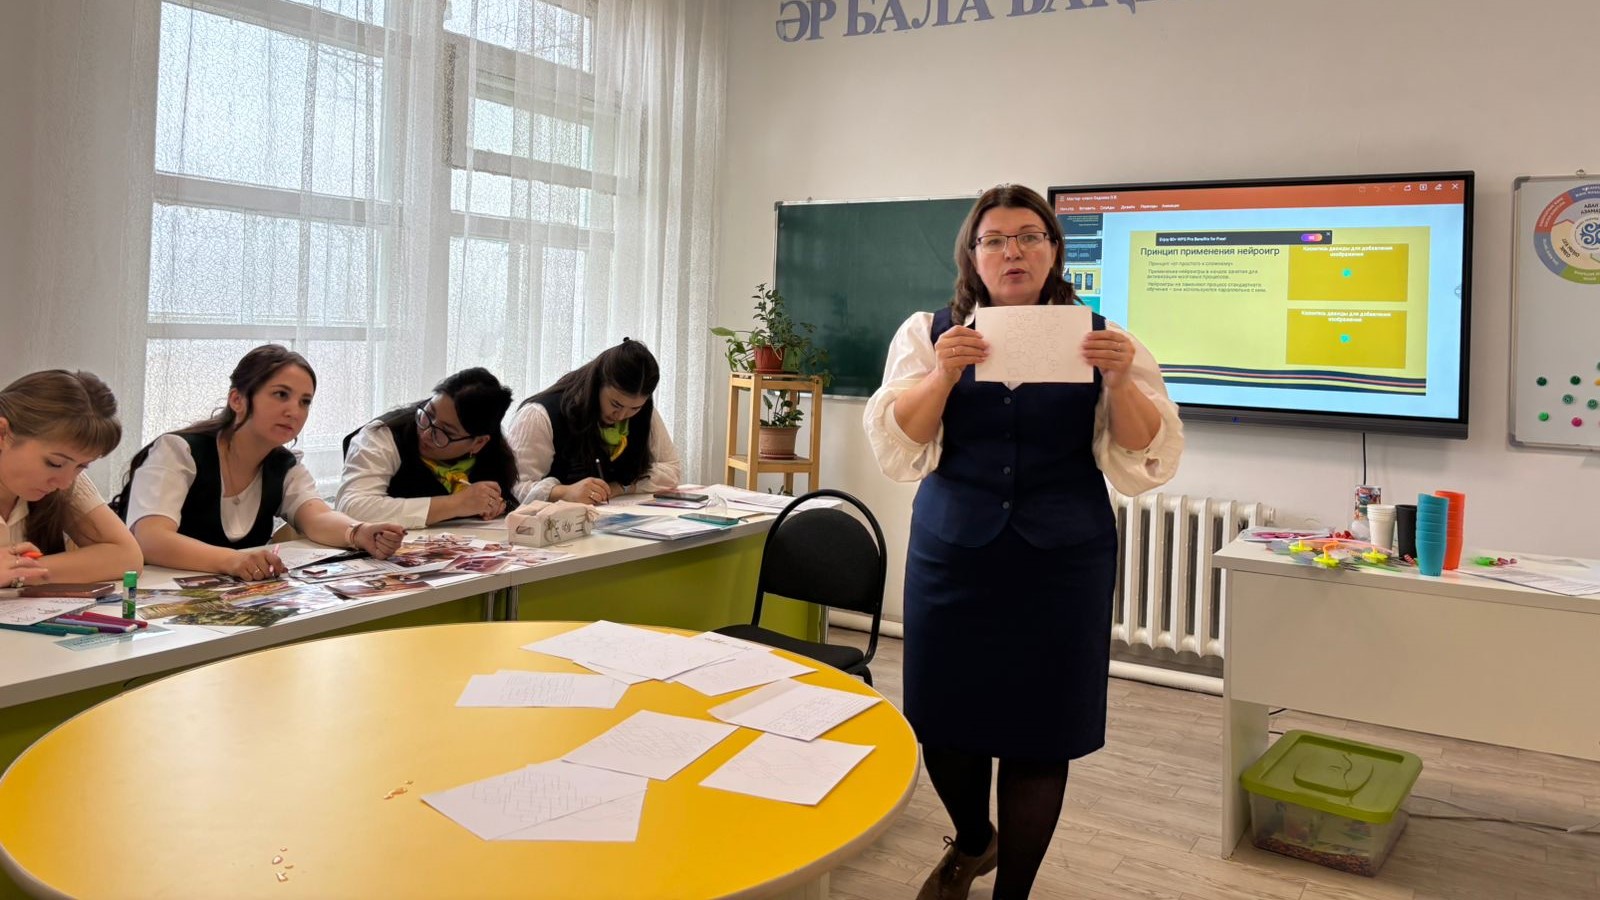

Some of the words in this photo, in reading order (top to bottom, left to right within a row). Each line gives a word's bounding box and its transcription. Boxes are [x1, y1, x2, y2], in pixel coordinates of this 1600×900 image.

[775, 0, 837, 42] ӘР
[1140, 247, 1179, 257] Принцип
[1180, 247, 1236, 257] применения
[1237, 246, 1280, 257] нейроигр
